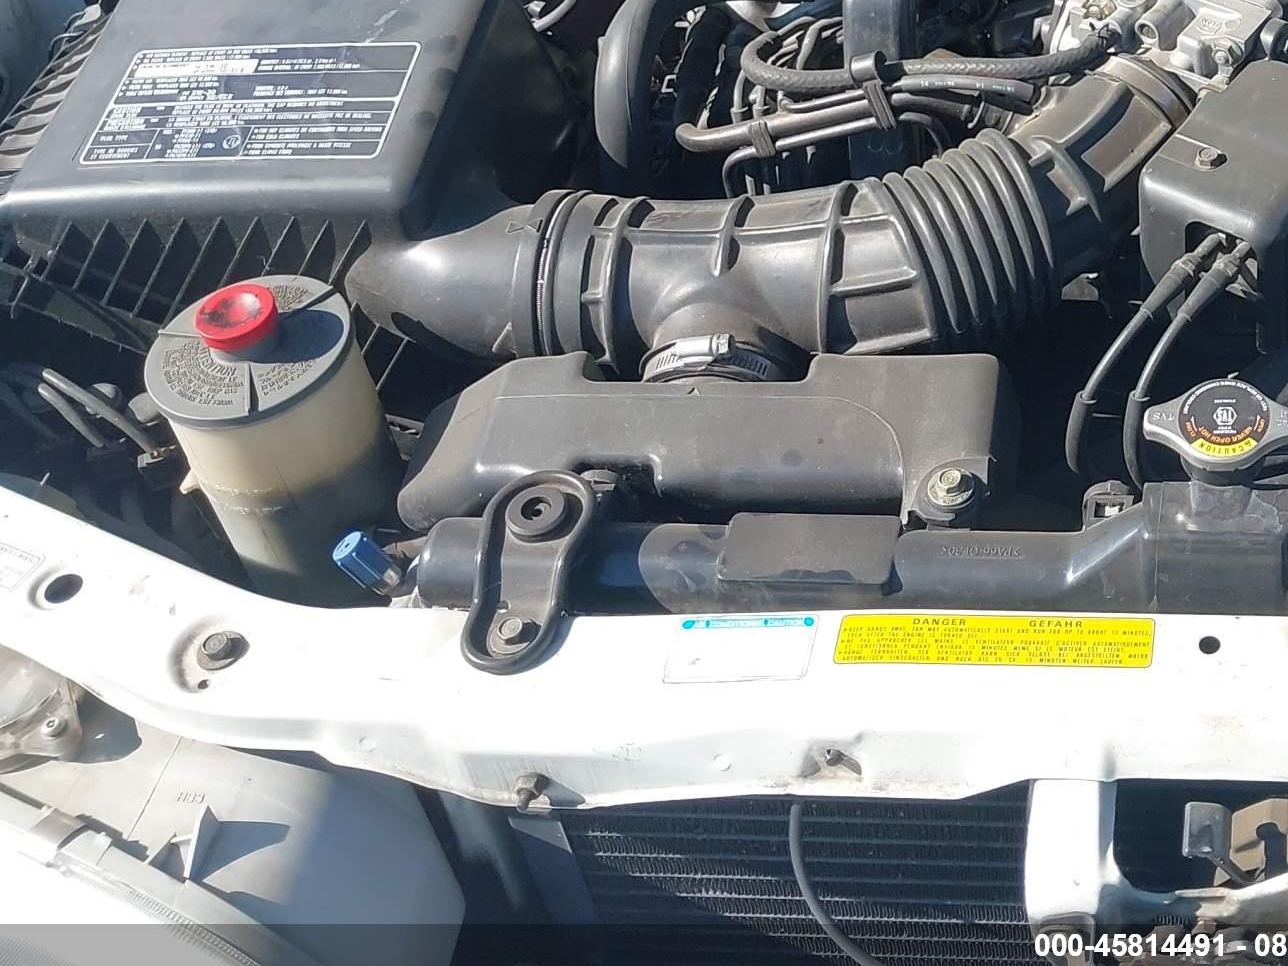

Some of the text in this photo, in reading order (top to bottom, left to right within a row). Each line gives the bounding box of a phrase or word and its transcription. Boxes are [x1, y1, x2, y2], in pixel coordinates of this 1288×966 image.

[1153, 411, 1176, 422] TVS
[1217, 409, 1233, 424] TVS
[1232, 425, 1253, 442] NEVER
[1210, 434, 1232, 445] OPEN
[1198, 440, 1246, 456] CAUTION
[912, 618, 967, 626] DANGER
[1028, 620, 1083, 629] GEFAHR
